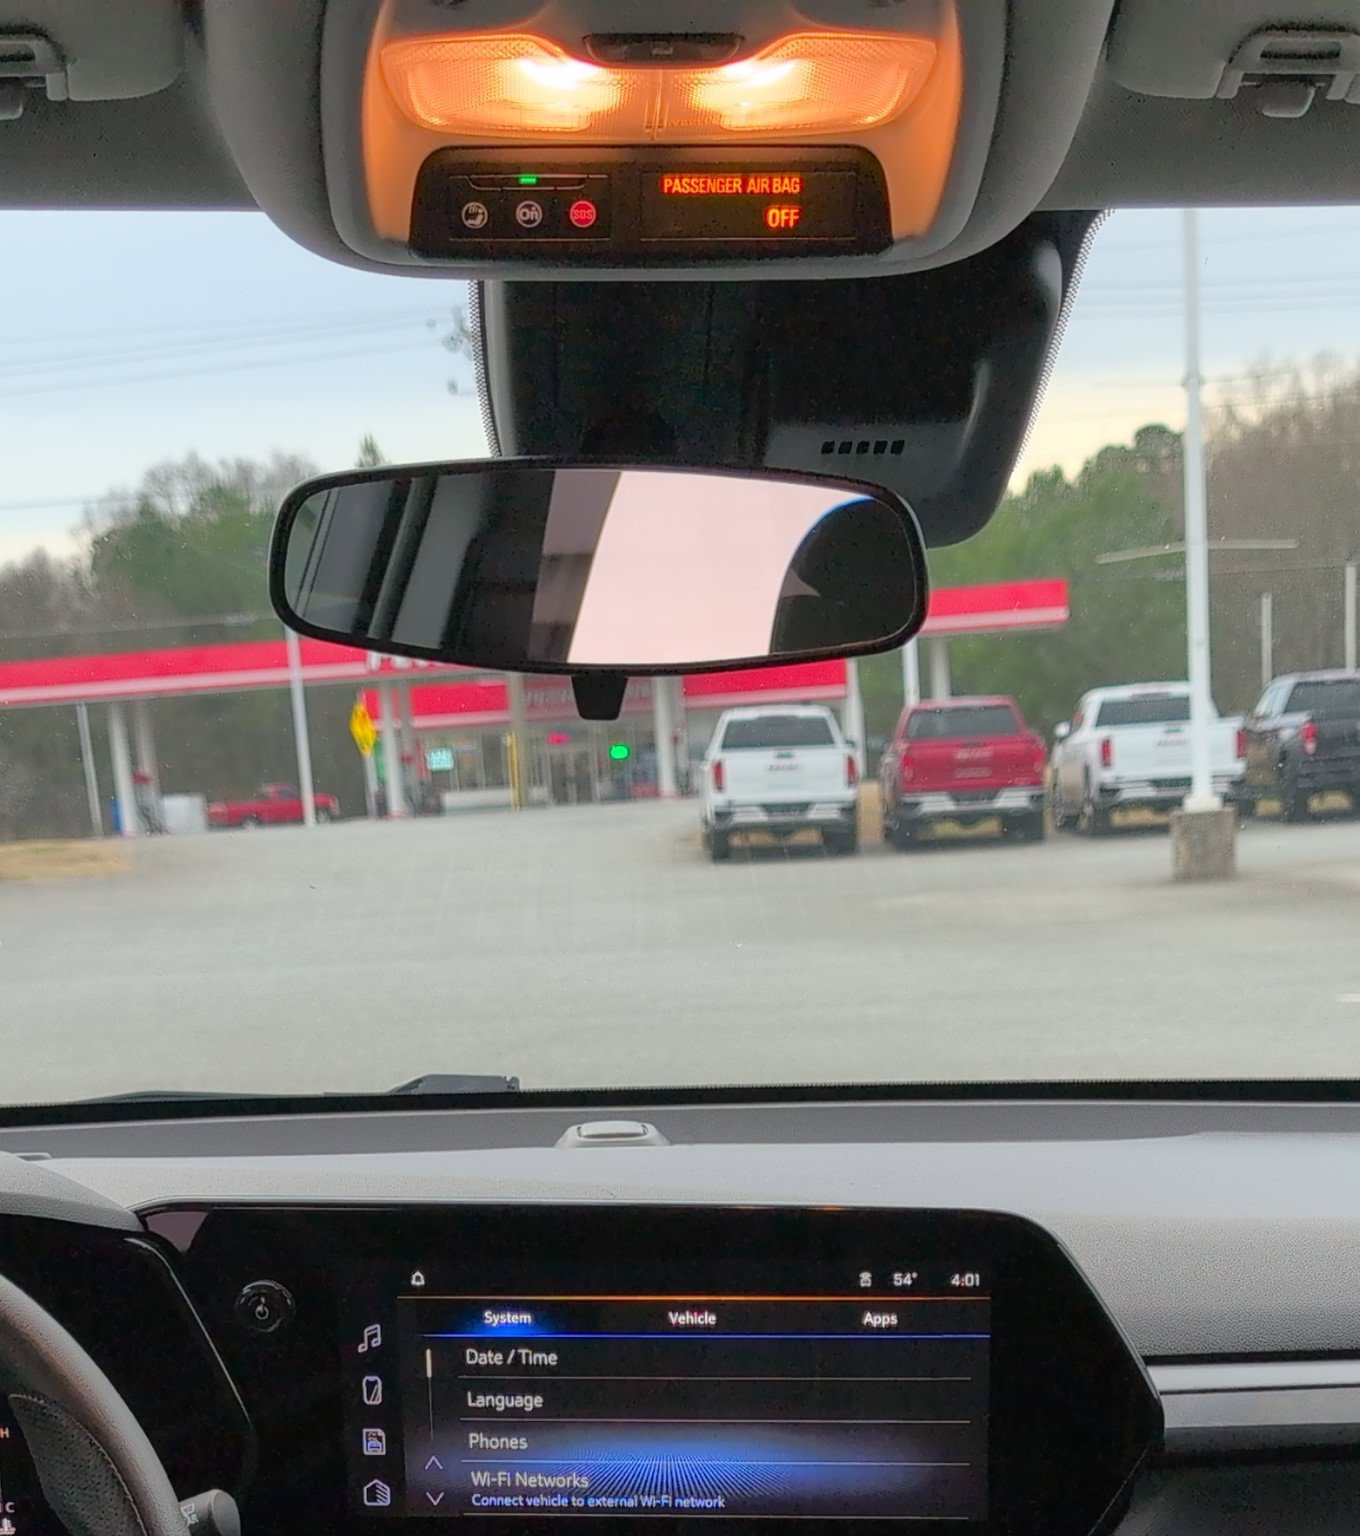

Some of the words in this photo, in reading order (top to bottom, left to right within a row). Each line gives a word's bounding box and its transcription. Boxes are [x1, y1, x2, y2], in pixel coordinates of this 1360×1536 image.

[663, 177, 742, 194] PASSENGER
[747, 177, 769, 194] AIR
[772, 177, 801, 194] BAG
[573, 208, 595, 220] SOS
[767, 208, 800, 228] OFF
[951, 1272, 981, 1287] 4:01
[484, 1311, 532, 1325] System
[668, 1311, 717, 1326] Vehicle
[863, 1312, 898, 1327] Apps
[465, 1349, 504, 1365] Date
[518, 1350, 558, 1366] Time
[467, 1391, 544, 1411] Language
[0, 1428, 9, 1438] H
[468, 1433, 528, 1450] Phones
[471, 1471, 511, 1487] Wi-Fi
[515, 1472, 589, 1488] Networks
[5, 1502, 15, 1513] C
[471, 1494, 524, 1507] Connect
[525, 1495, 569, 1507] vehicle
[571, 1496, 585, 1507] to
[587, 1496, 638, 1508] external
[640, 1496, 672, 1508] Wi-Fi
[675, 1496, 725, 1508] network
